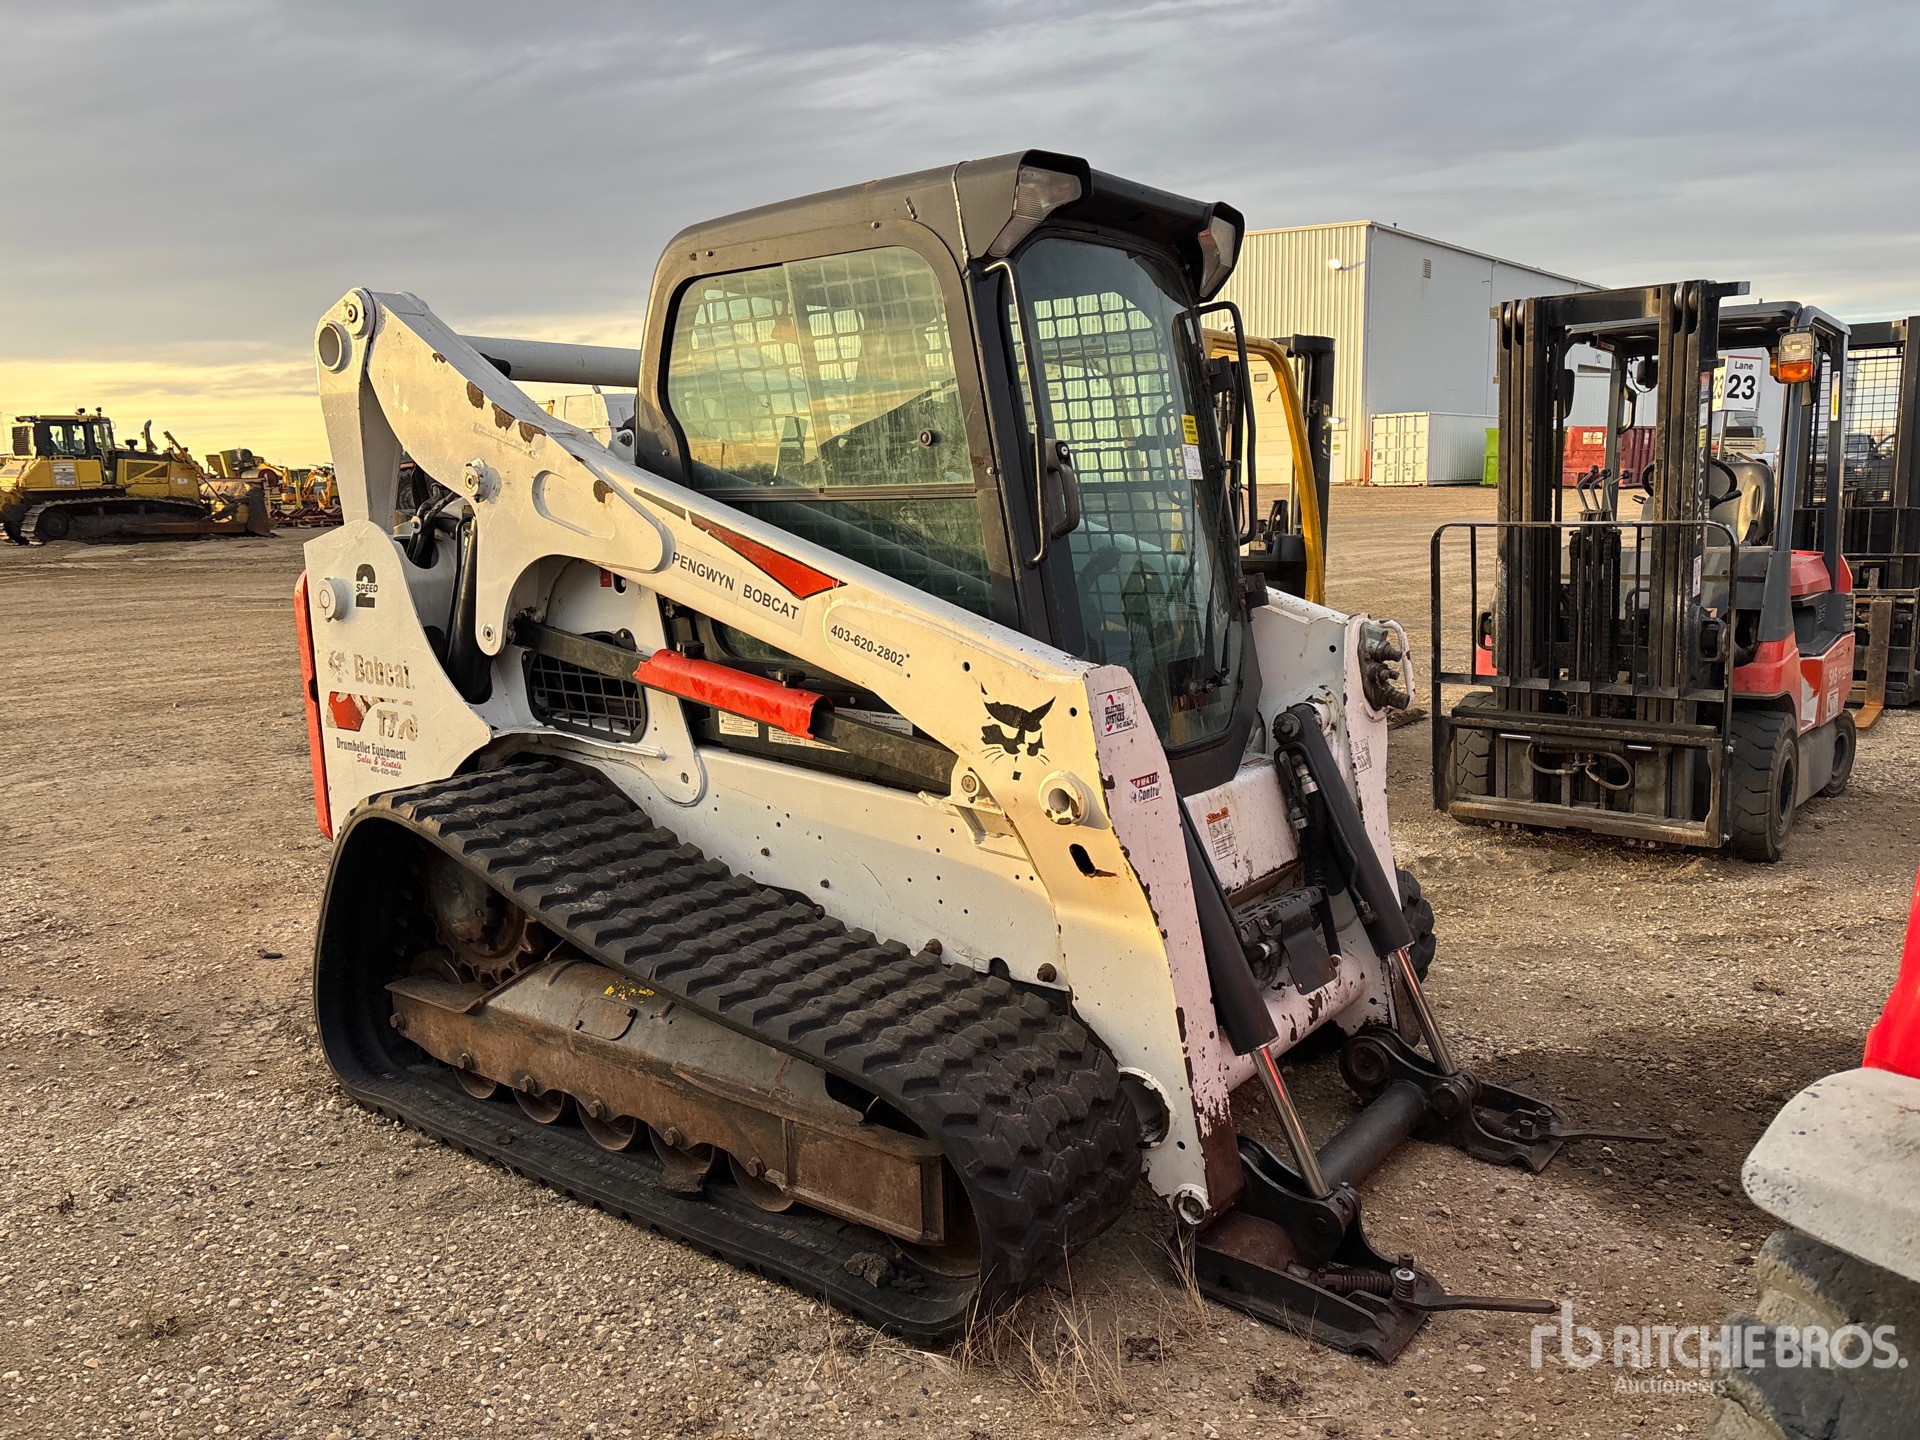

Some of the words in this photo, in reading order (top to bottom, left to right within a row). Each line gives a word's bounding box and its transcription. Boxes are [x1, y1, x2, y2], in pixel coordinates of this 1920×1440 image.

[1734, 361, 1754, 370] Lane
[1726, 374, 1756, 400] 23
[1695, 445, 1705, 546] TOYOTA
[356, 583, 379, 593] SPEED
[671, 551, 735, 592] PENGWYN
[743, 583, 800, 620] BOBCAT
[830, 624, 905, 667] 403-620-2802
[336, 736, 371, 755] Drumheller
[371, 743, 407, 761] Equipment
